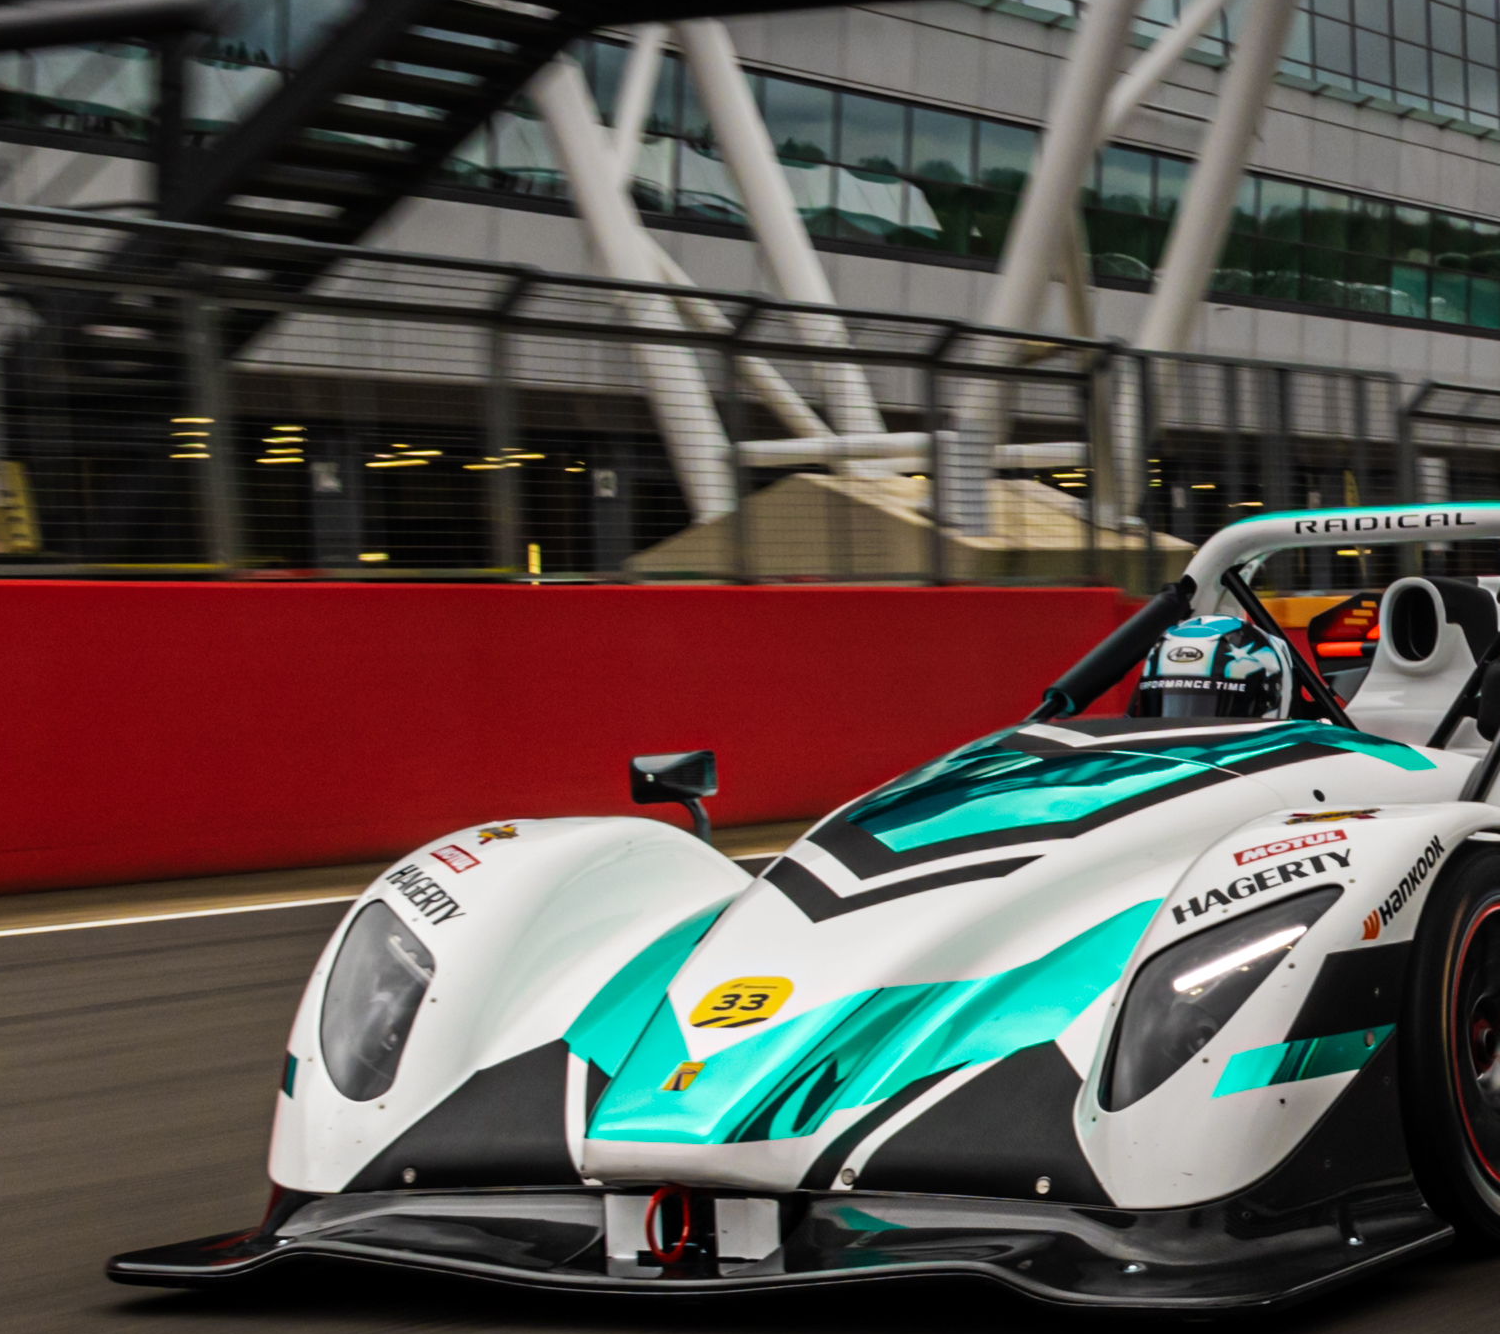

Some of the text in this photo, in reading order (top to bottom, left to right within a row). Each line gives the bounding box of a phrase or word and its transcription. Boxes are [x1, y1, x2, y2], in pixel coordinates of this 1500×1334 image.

[1294, 512, 1476, 534] RADICAL
[1175, 646, 1199, 659] Arai
[1216, 681, 1246, 692] TIME
[1241, 830, 1346, 864] MOTUL
[385, 864, 467, 926] HAGERTY
[1172, 848, 1352, 925] HAGERTY
[711, 993, 770, 1011] 33
